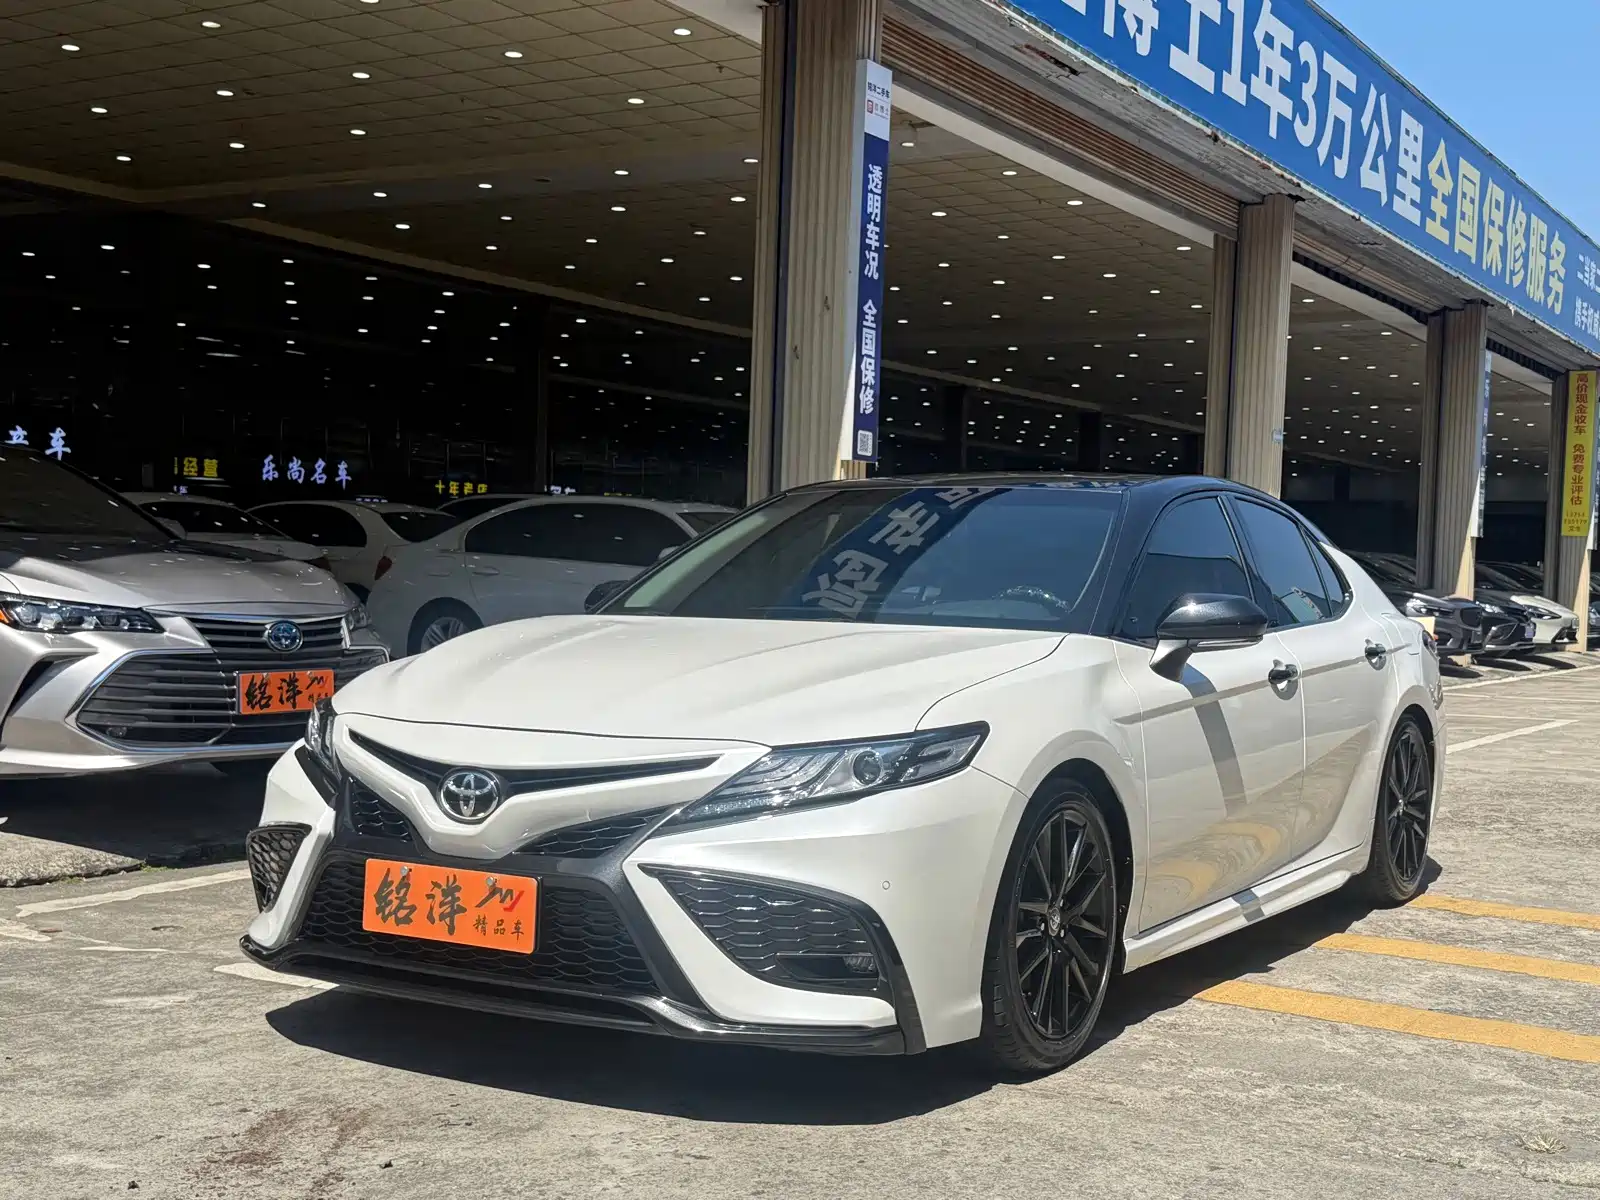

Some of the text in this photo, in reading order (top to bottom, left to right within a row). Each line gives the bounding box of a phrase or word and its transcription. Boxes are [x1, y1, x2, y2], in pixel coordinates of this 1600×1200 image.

[1058, 0, 1567, 315] 士1年3万公里全国保修服务
[859, 163, 883, 415] 透明车况 全国保修
[1573, 373, 1589, 435] 高价现金收车
[174, 456, 218, 477] 经营
[261, 454, 352, 489] 乐尚名车
[1569, 443, 1586, 506] 免费专业评估
[473, 914, 524, 943] 精品车
